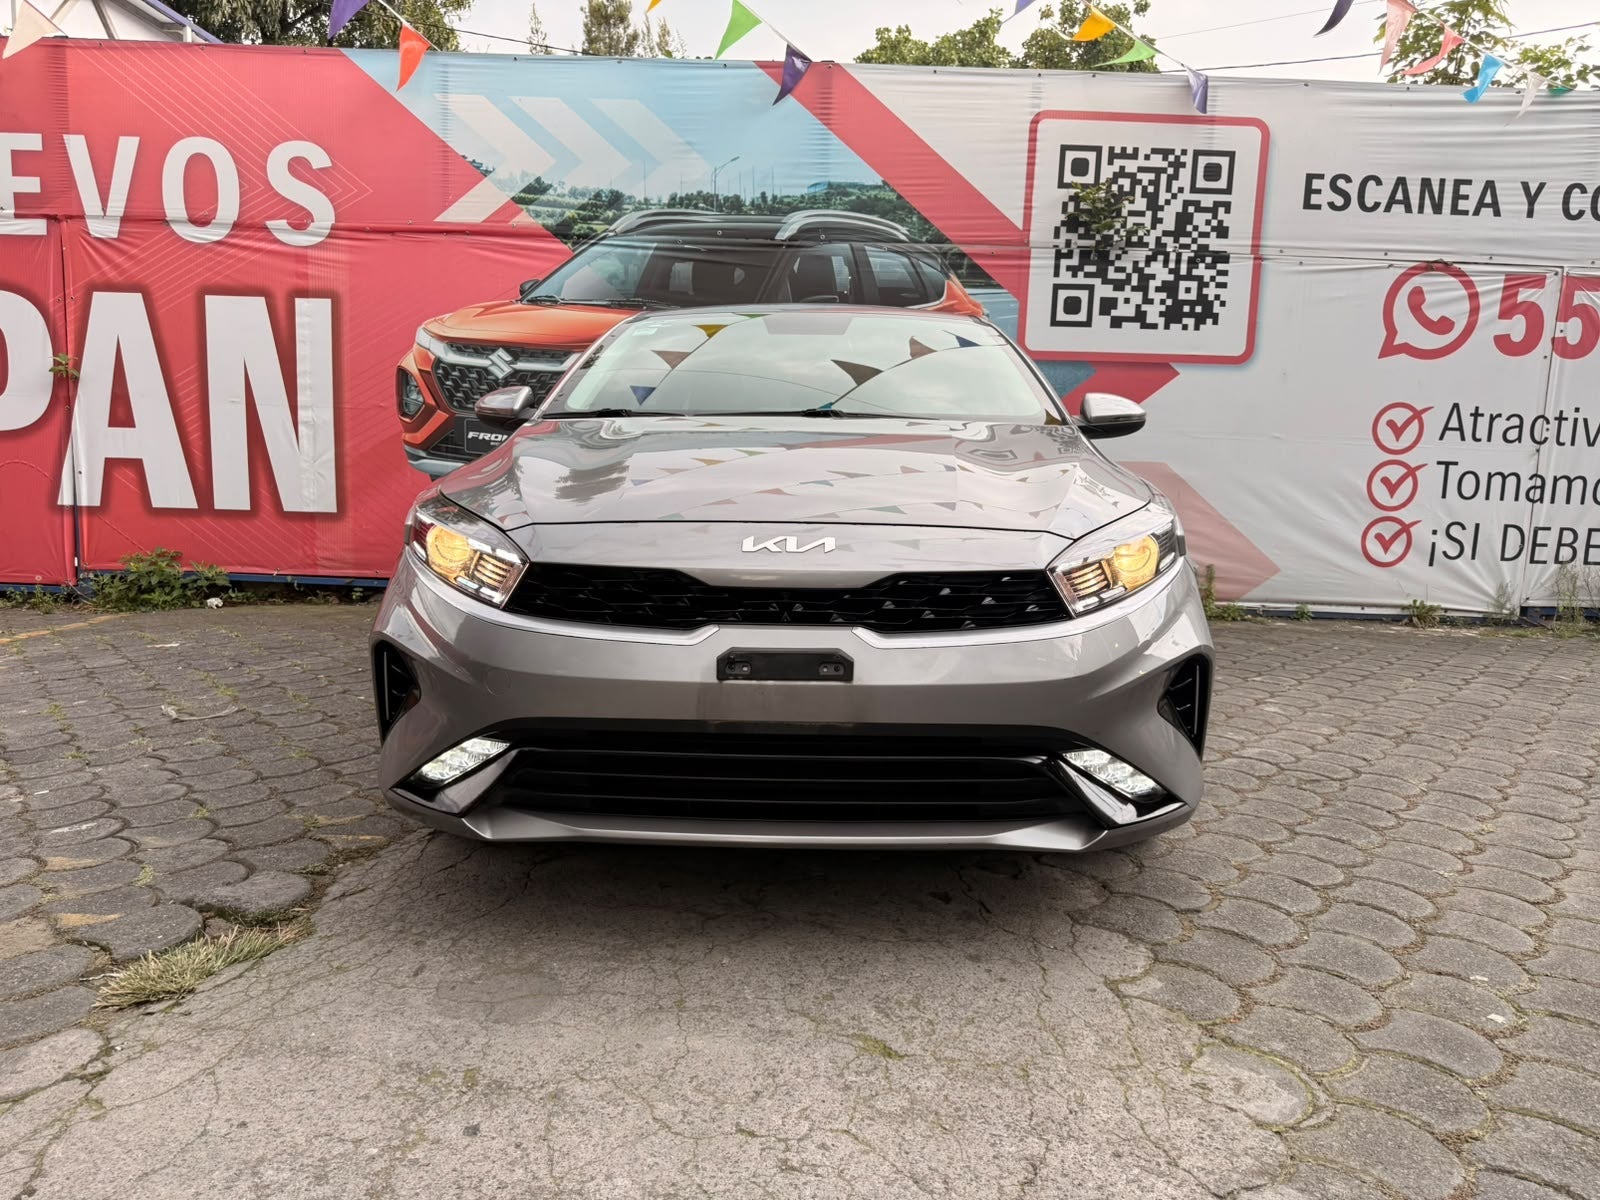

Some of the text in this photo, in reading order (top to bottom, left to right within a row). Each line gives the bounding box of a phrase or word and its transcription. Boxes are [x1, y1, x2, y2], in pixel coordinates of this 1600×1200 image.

[0, 132, 336, 247] EVOS
[1302, 173, 1502, 218] ESCANEA
[1520, 181, 1547, 219] Y
[1493, 273, 1600, 360] 55
[1438, 402, 1600, 448] Atractiv
[742, 535, 836, 554] KIA
[1428, 521, 1600, 567] ¡SI DEBE
